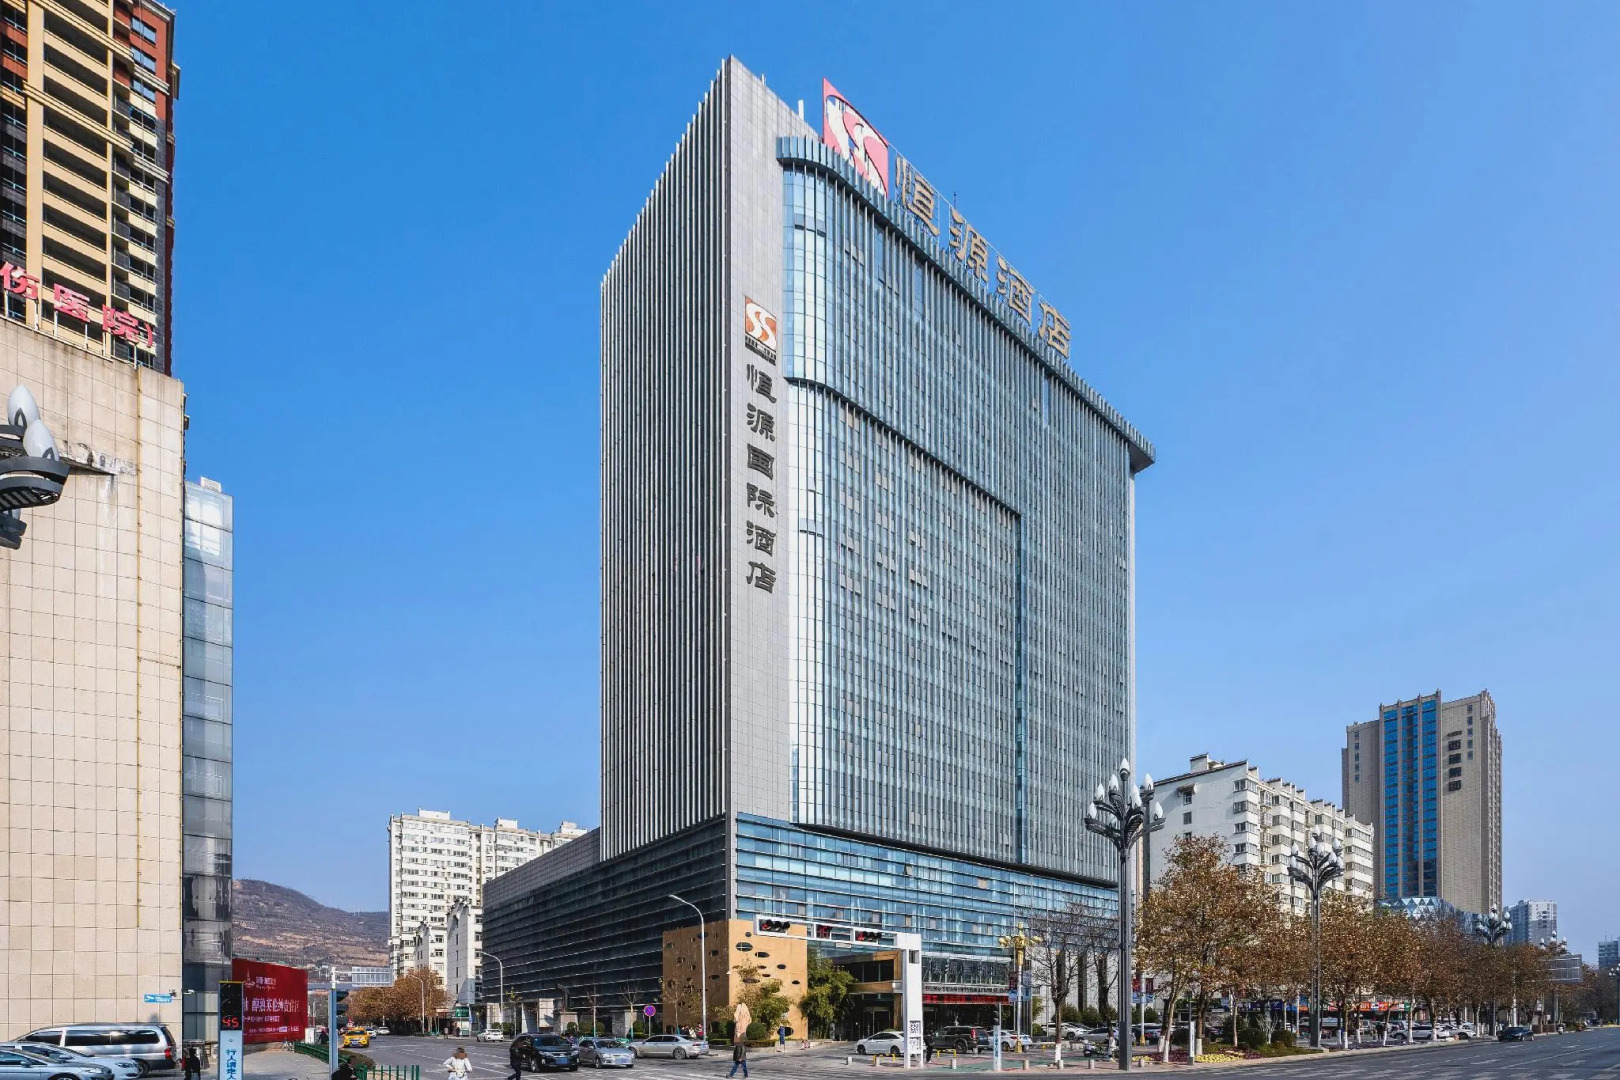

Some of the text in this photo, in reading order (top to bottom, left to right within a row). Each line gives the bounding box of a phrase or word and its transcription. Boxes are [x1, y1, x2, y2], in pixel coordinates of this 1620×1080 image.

[895, 155, 1072, 359] 恒源酒店
[746, 363, 778, 595] 恒源国际酒店
